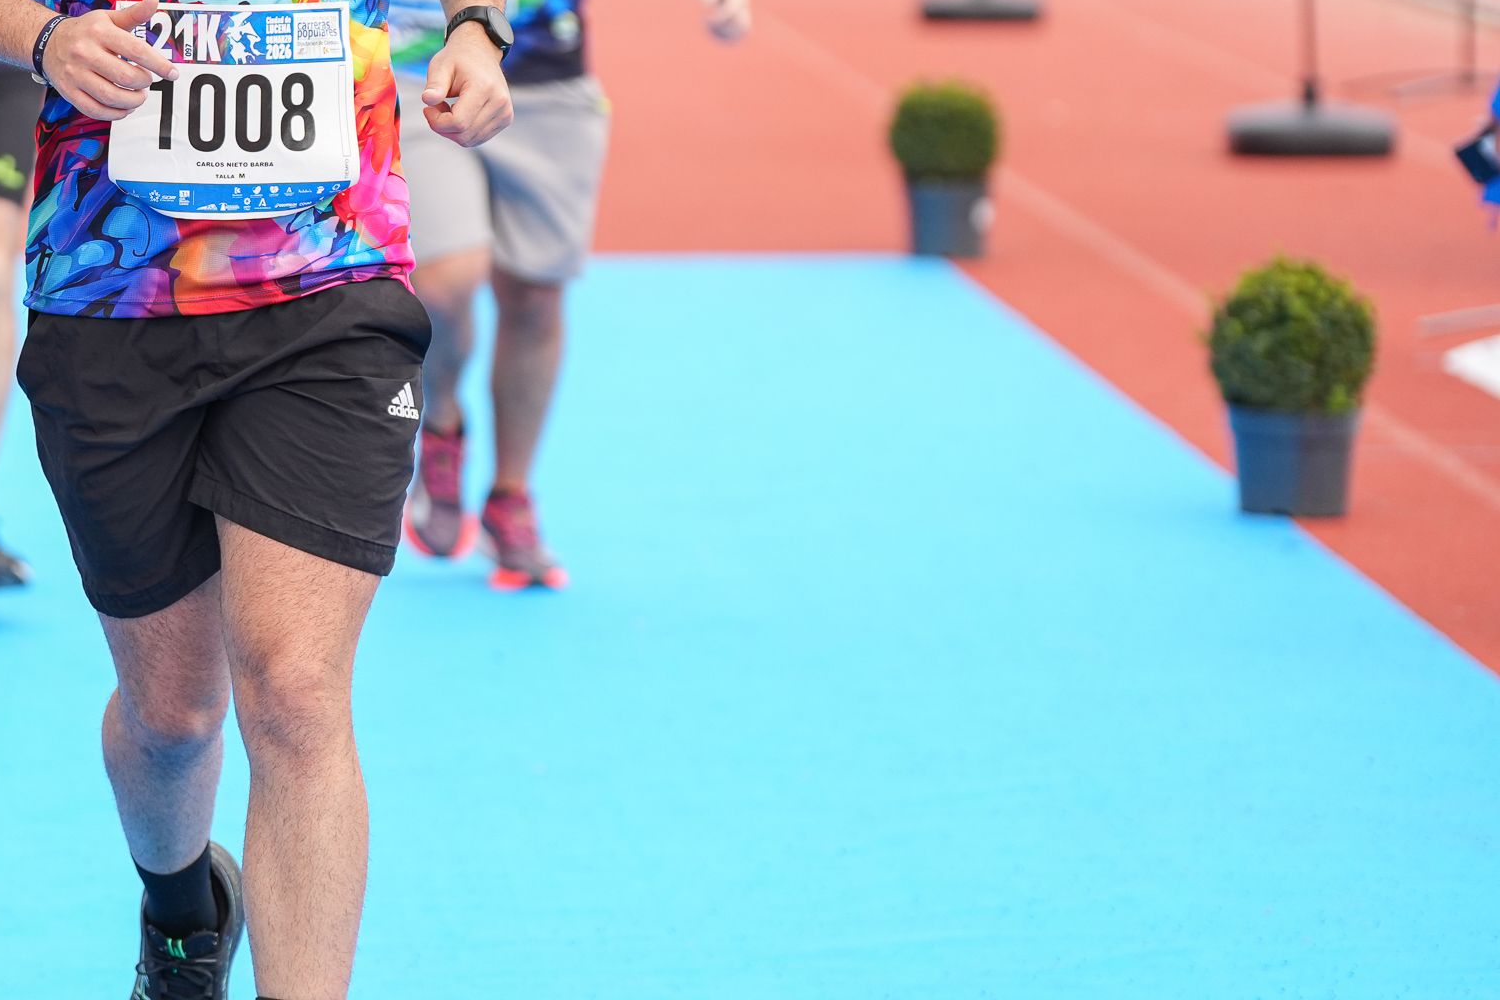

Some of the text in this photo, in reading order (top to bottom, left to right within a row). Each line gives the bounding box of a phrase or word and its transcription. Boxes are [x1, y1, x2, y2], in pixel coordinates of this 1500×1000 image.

[297, 21, 331, 30] carreras
[150, 11, 222, 62] 21K
[297, 28, 338, 40] populares
[266, 44, 292, 60] 2026
[149, 72, 316, 152] 1008
[388, 404, 419, 420] adidas
